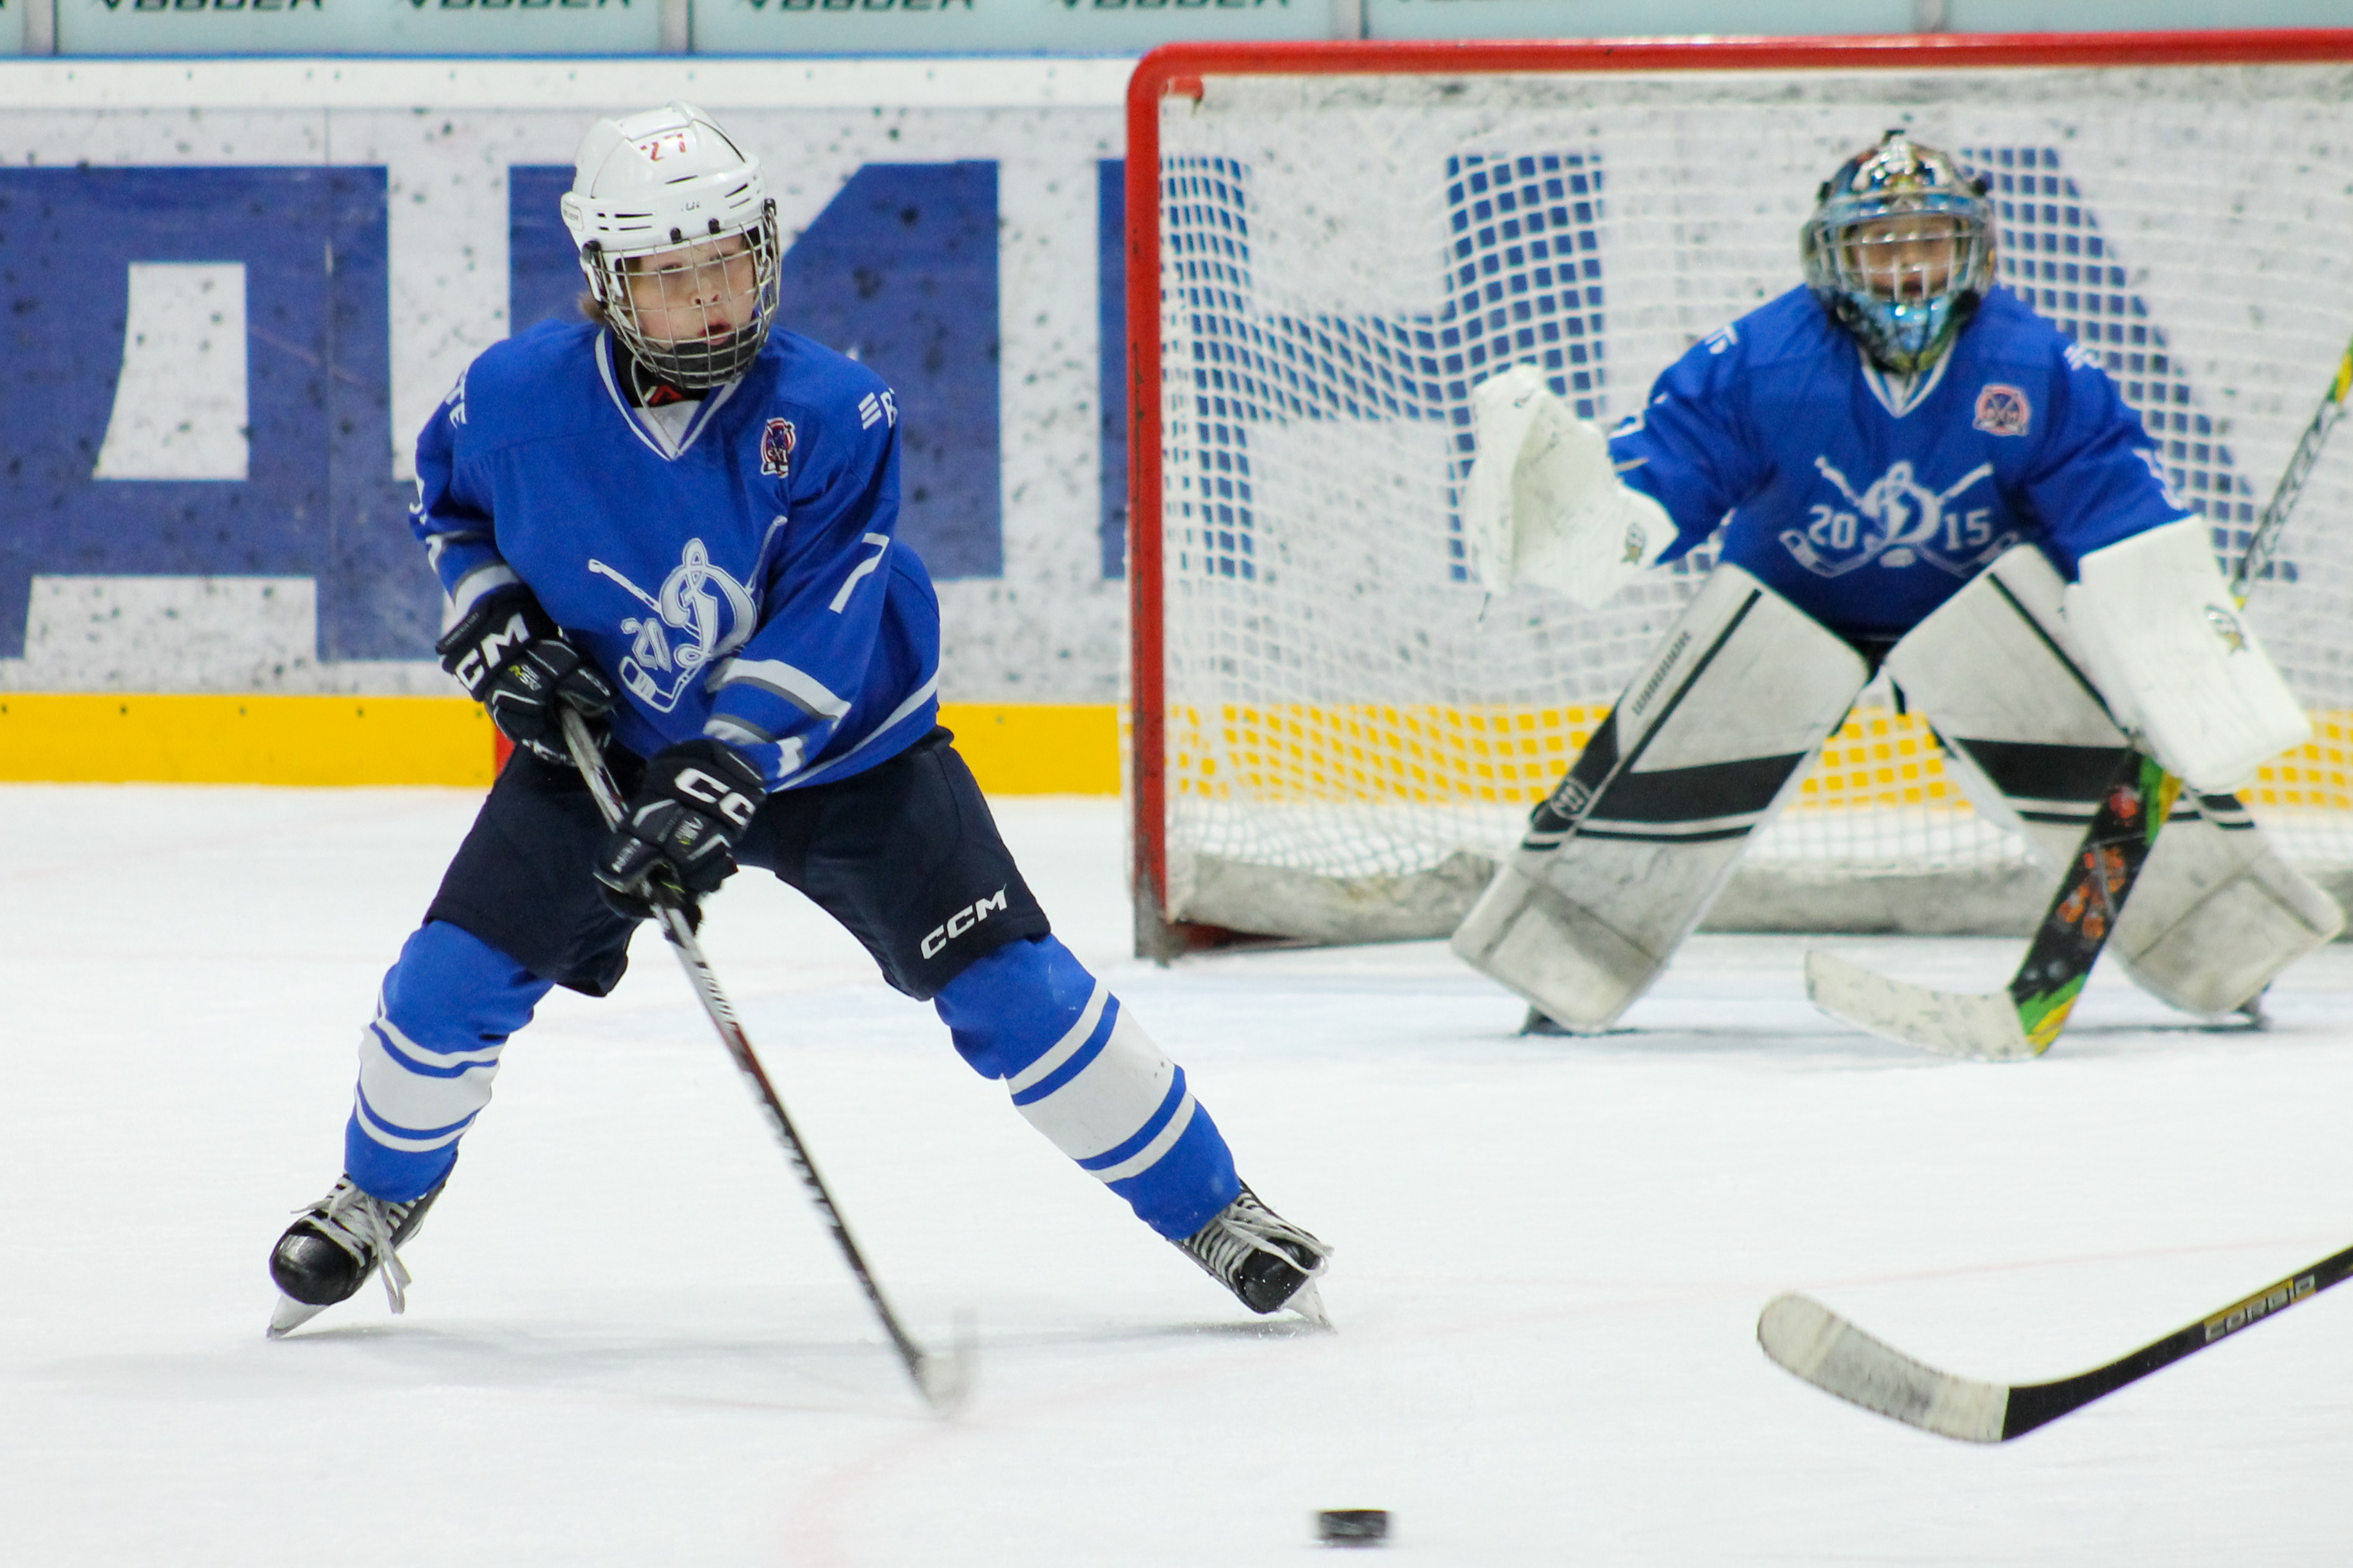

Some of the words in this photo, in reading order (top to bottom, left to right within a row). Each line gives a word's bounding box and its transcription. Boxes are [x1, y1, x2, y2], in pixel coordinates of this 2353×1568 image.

[640, 133, 686, 162] 27
[1808, 504, 1858, 550] 20
[1945, 508, 1992, 551] 15
[454, 611, 531, 691] CM
[674, 768, 756, 832] CC
[920, 887, 1008, 959] CCM
